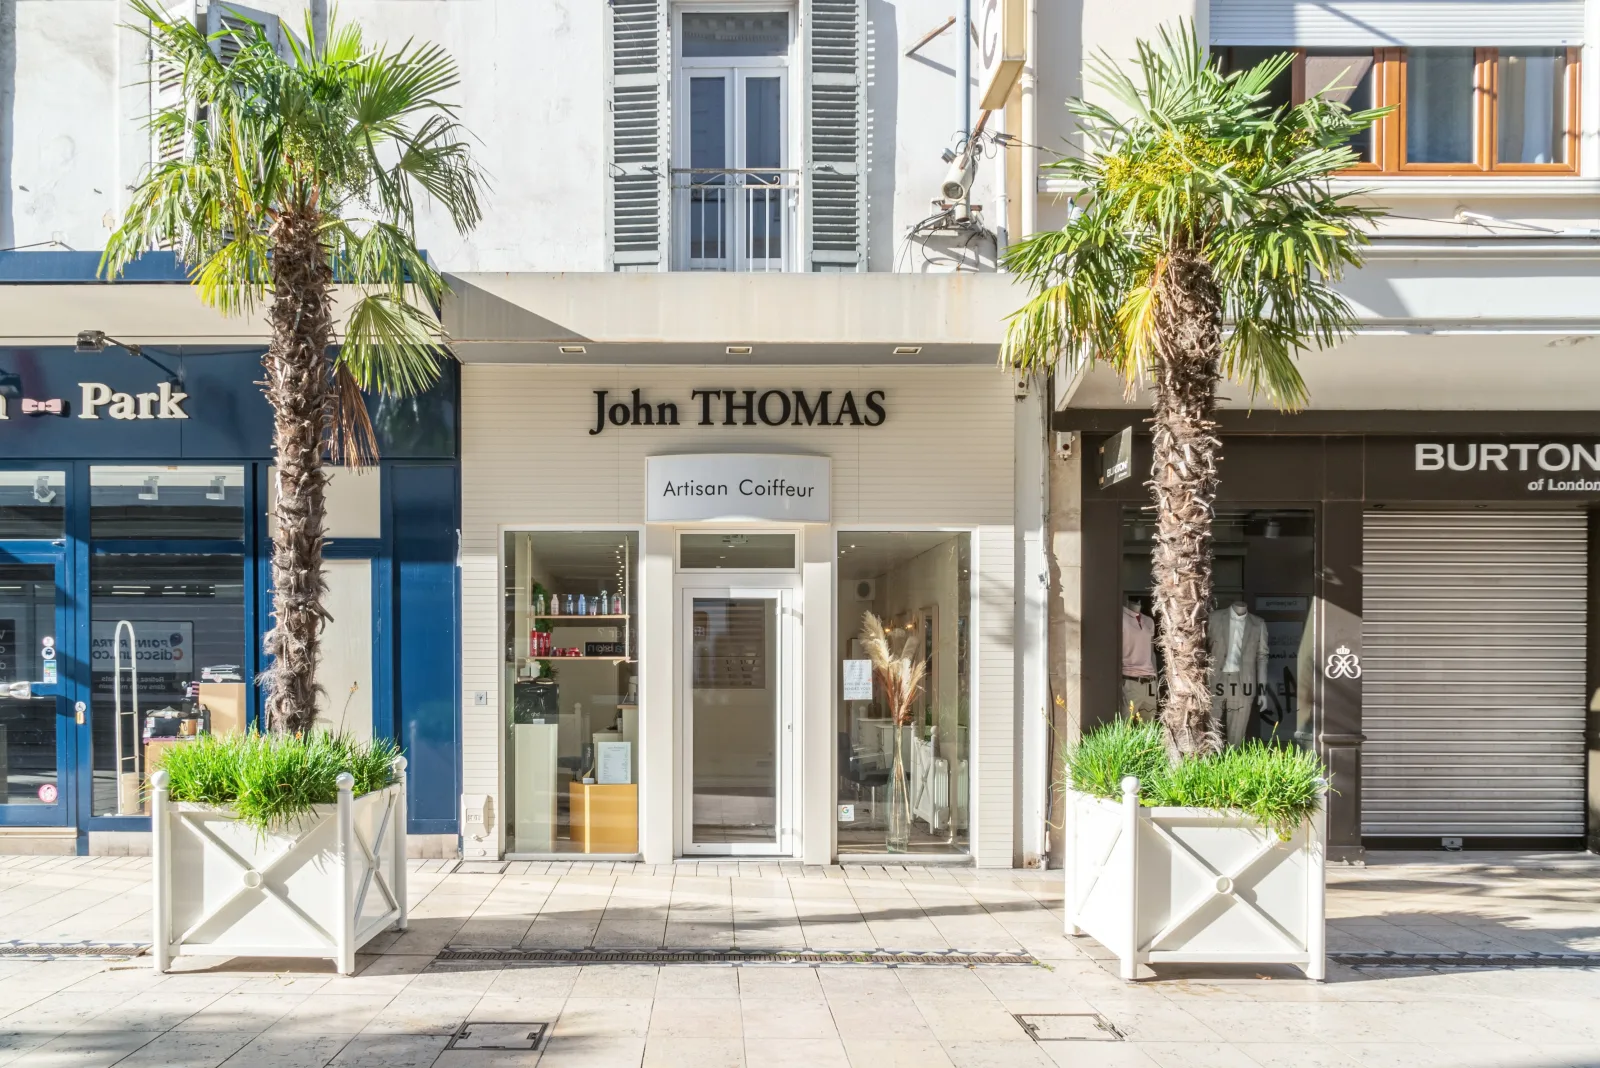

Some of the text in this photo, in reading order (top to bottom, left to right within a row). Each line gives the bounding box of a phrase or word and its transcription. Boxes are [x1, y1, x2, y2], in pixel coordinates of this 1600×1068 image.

[78, 382, 190, 420] Park
[589, 388, 887, 435] John THOMAS
[1415, 443, 1600, 471] BURTON
[662, 479, 815, 498] Artisan Coiffeur
[1527, 478, 1600, 491] of London
